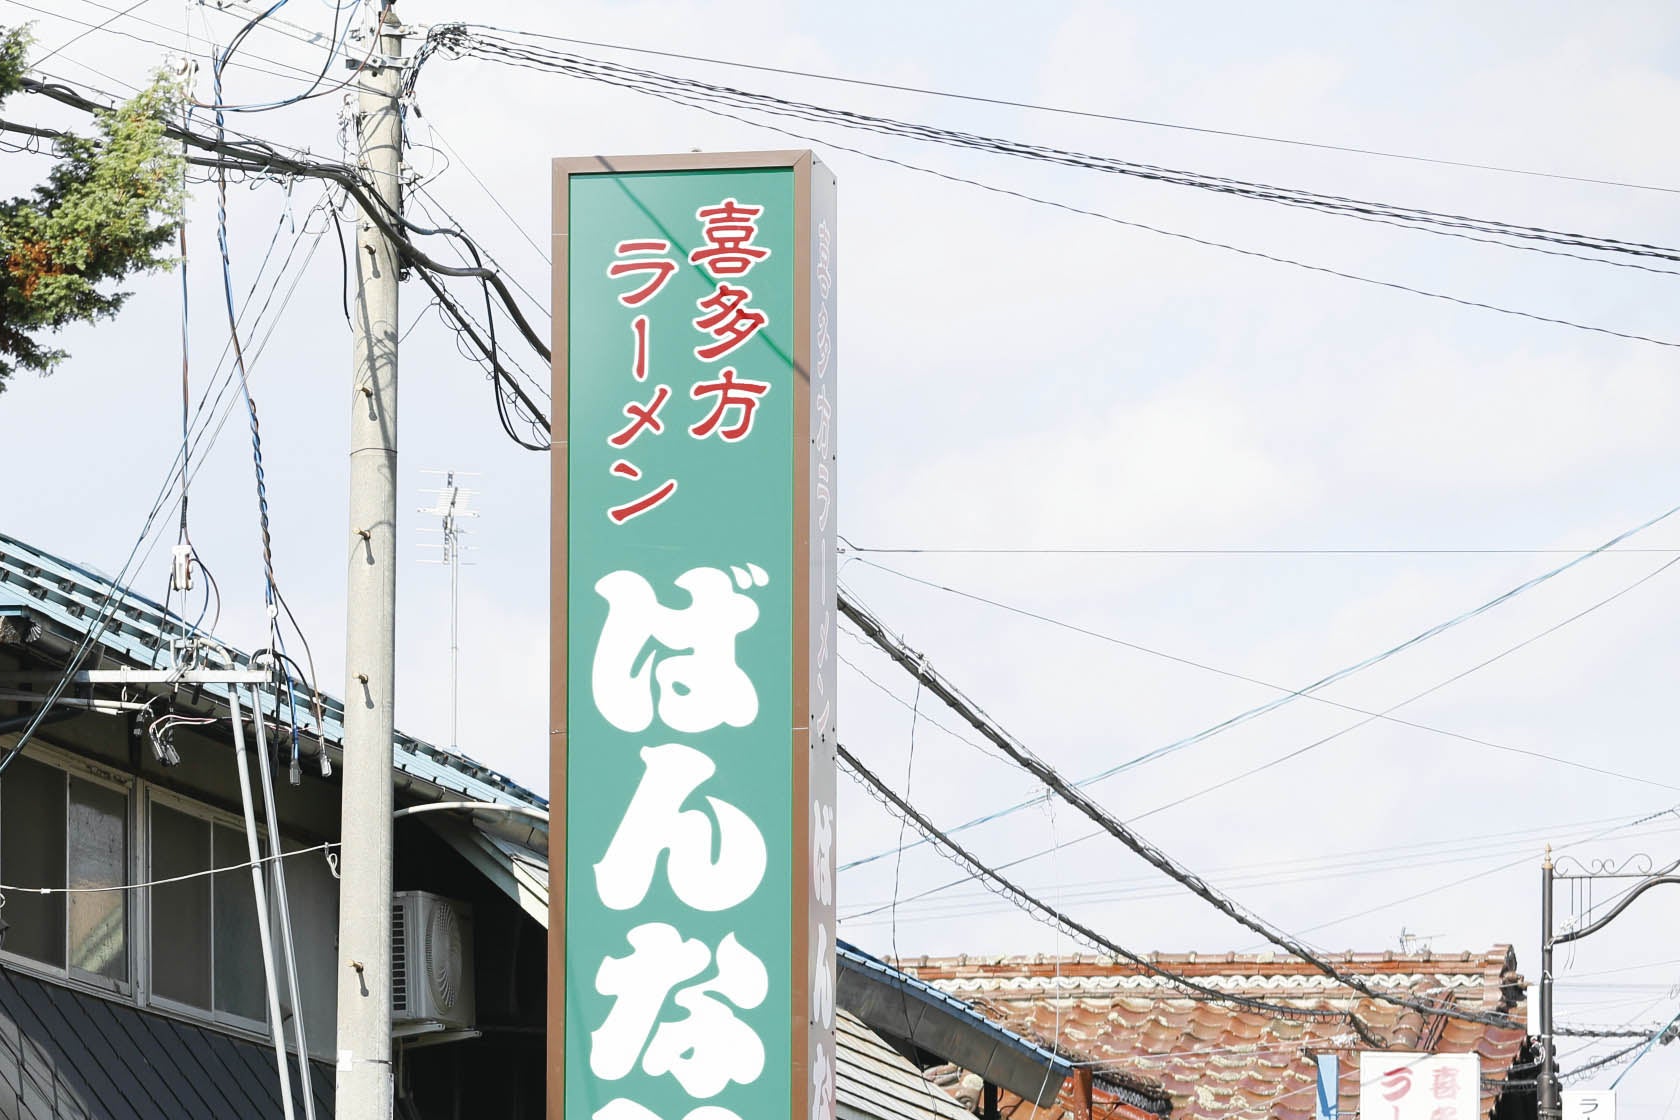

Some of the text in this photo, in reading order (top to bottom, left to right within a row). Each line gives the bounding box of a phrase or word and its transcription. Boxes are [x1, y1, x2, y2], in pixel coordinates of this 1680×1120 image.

[607, 239, 679, 525] ラーメン
[688, 198, 771, 443] 喜多方
